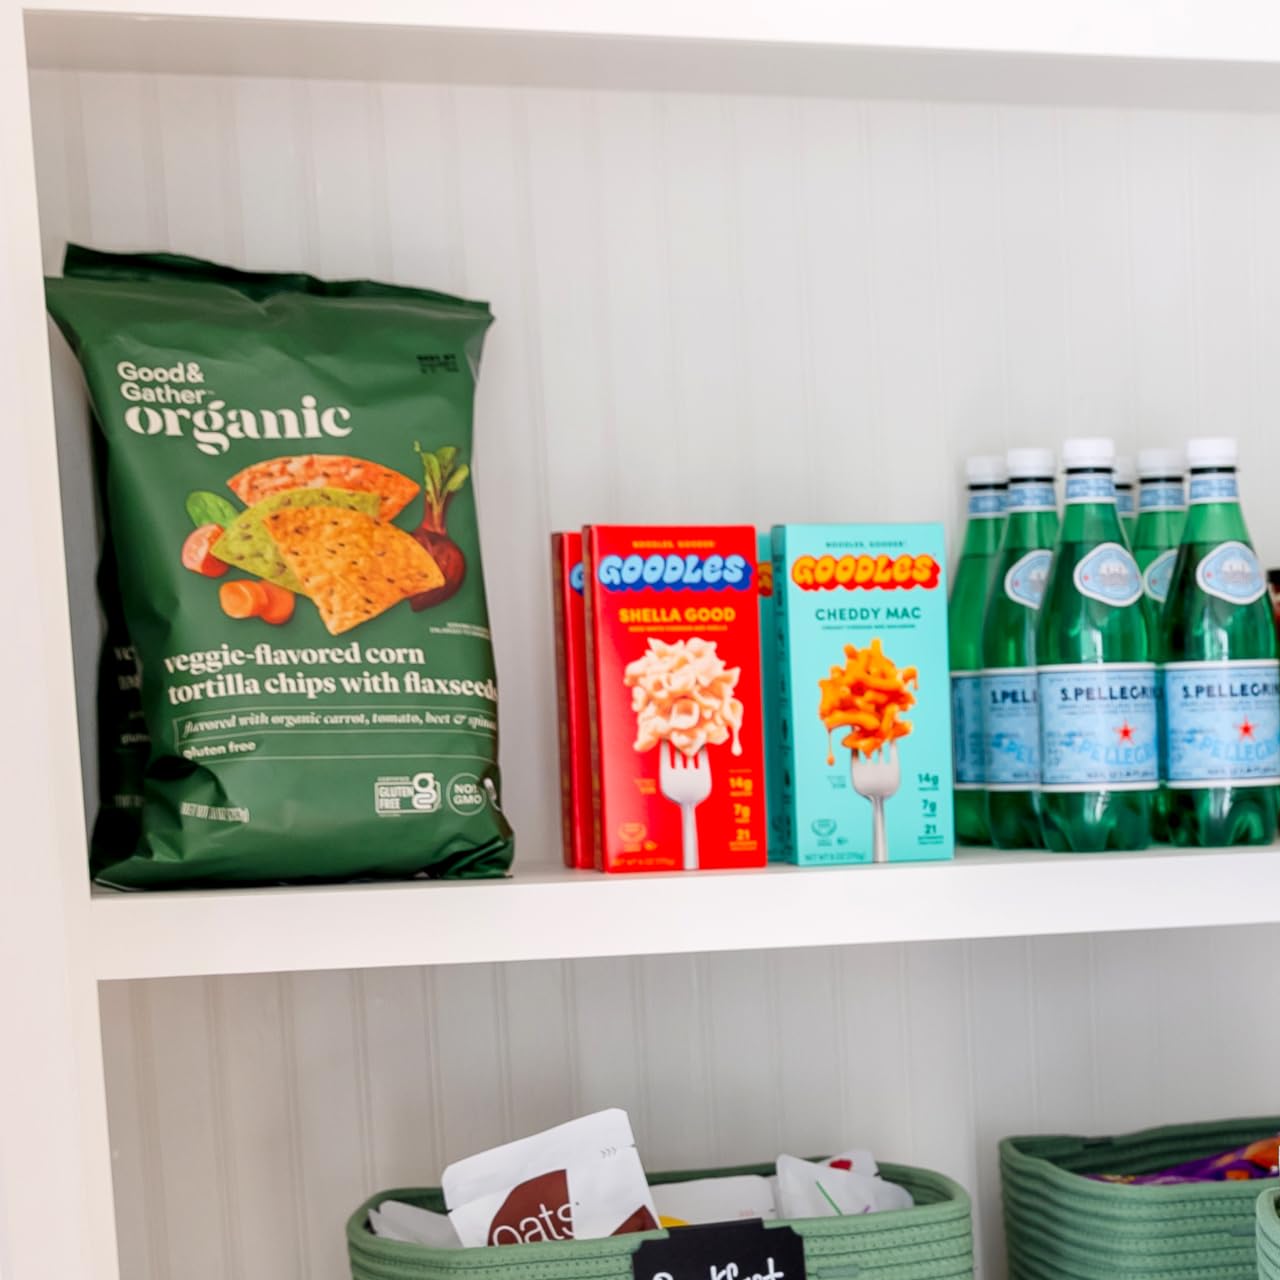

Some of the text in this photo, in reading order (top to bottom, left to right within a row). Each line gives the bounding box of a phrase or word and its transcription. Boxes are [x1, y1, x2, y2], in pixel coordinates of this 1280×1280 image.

[116, 361, 205, 384] Good&
[120, 381, 206, 404] Gather
[124, 394, 353, 456] organic
[598, 554, 752, 592] GOODLES
[791, 554, 941, 591] GOODLES
[619, 607, 736, 623] SHELLA GOOD
[815, 607, 922, 621] CHEDDY MAC
[164, 641, 361, 676] veggie-flavored
[365, 646, 426, 665] corn
[168, 672, 262, 705] tortilla
[264, 671, 338, 699] chips
[340, 671, 400, 694] with
[239, 712, 269, 727] with
[271, 711, 321, 729] organic
[228, 741, 257, 754] free
[918, 773, 939, 786] 14g
[452, 794, 483, 806] GMO
[922, 799, 938, 813] 7g
[924, 824, 937, 835] 21
[492, 1203, 574, 1247] oats
